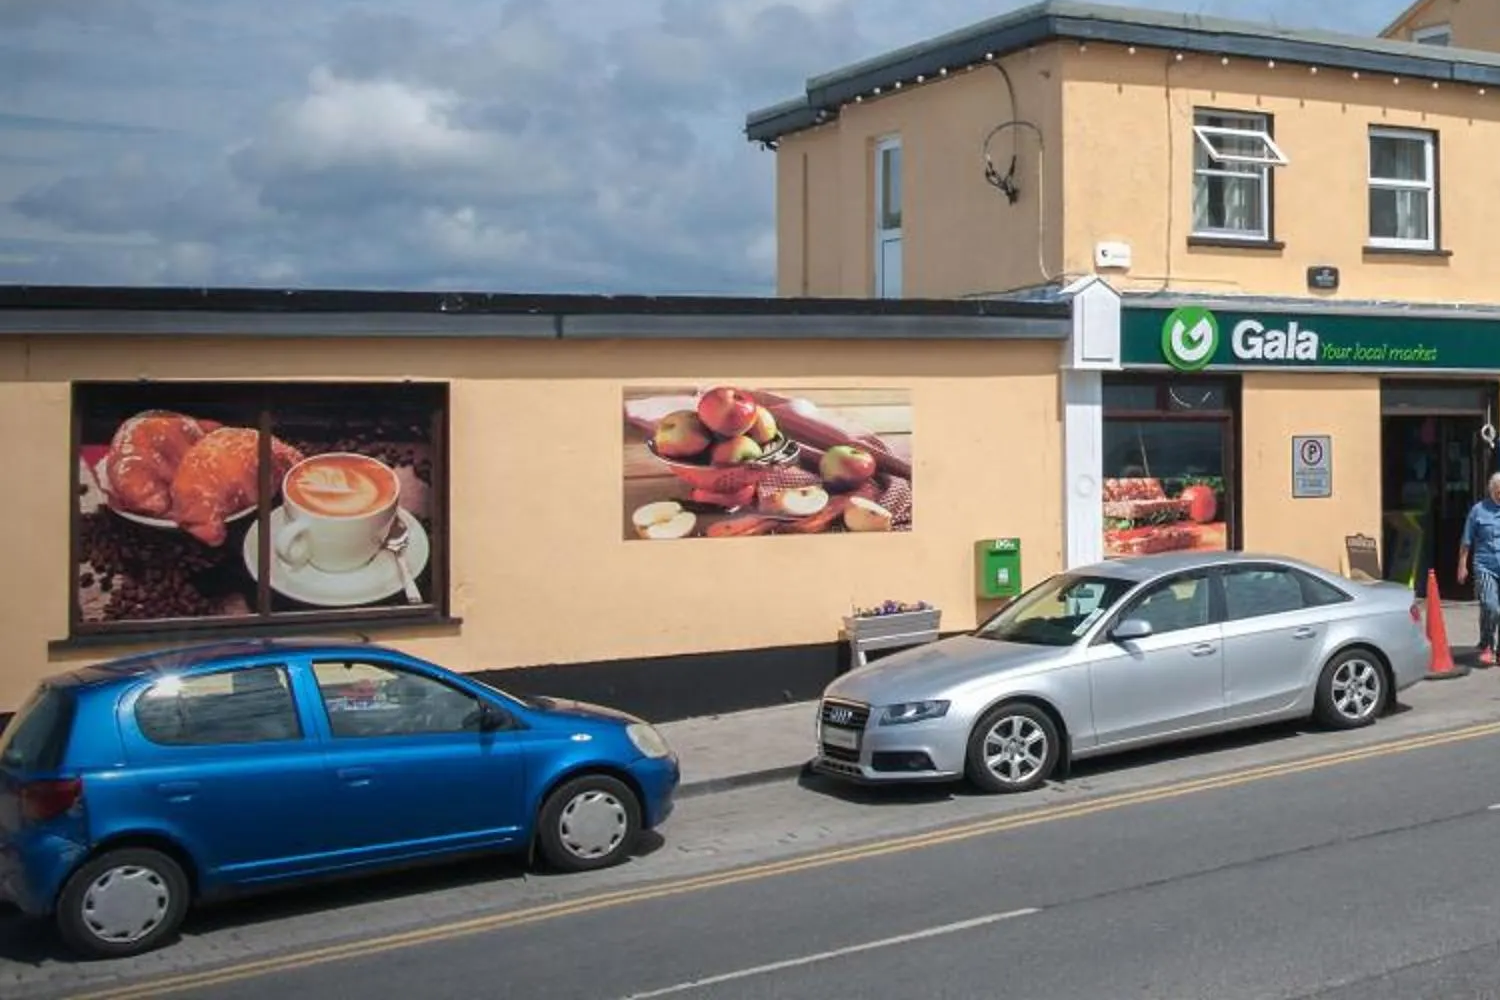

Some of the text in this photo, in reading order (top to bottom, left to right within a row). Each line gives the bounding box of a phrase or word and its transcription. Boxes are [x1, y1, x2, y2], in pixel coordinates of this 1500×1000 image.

[1231, 319, 1319, 361] Gala
[1321, 343, 1437, 361] Your local market
